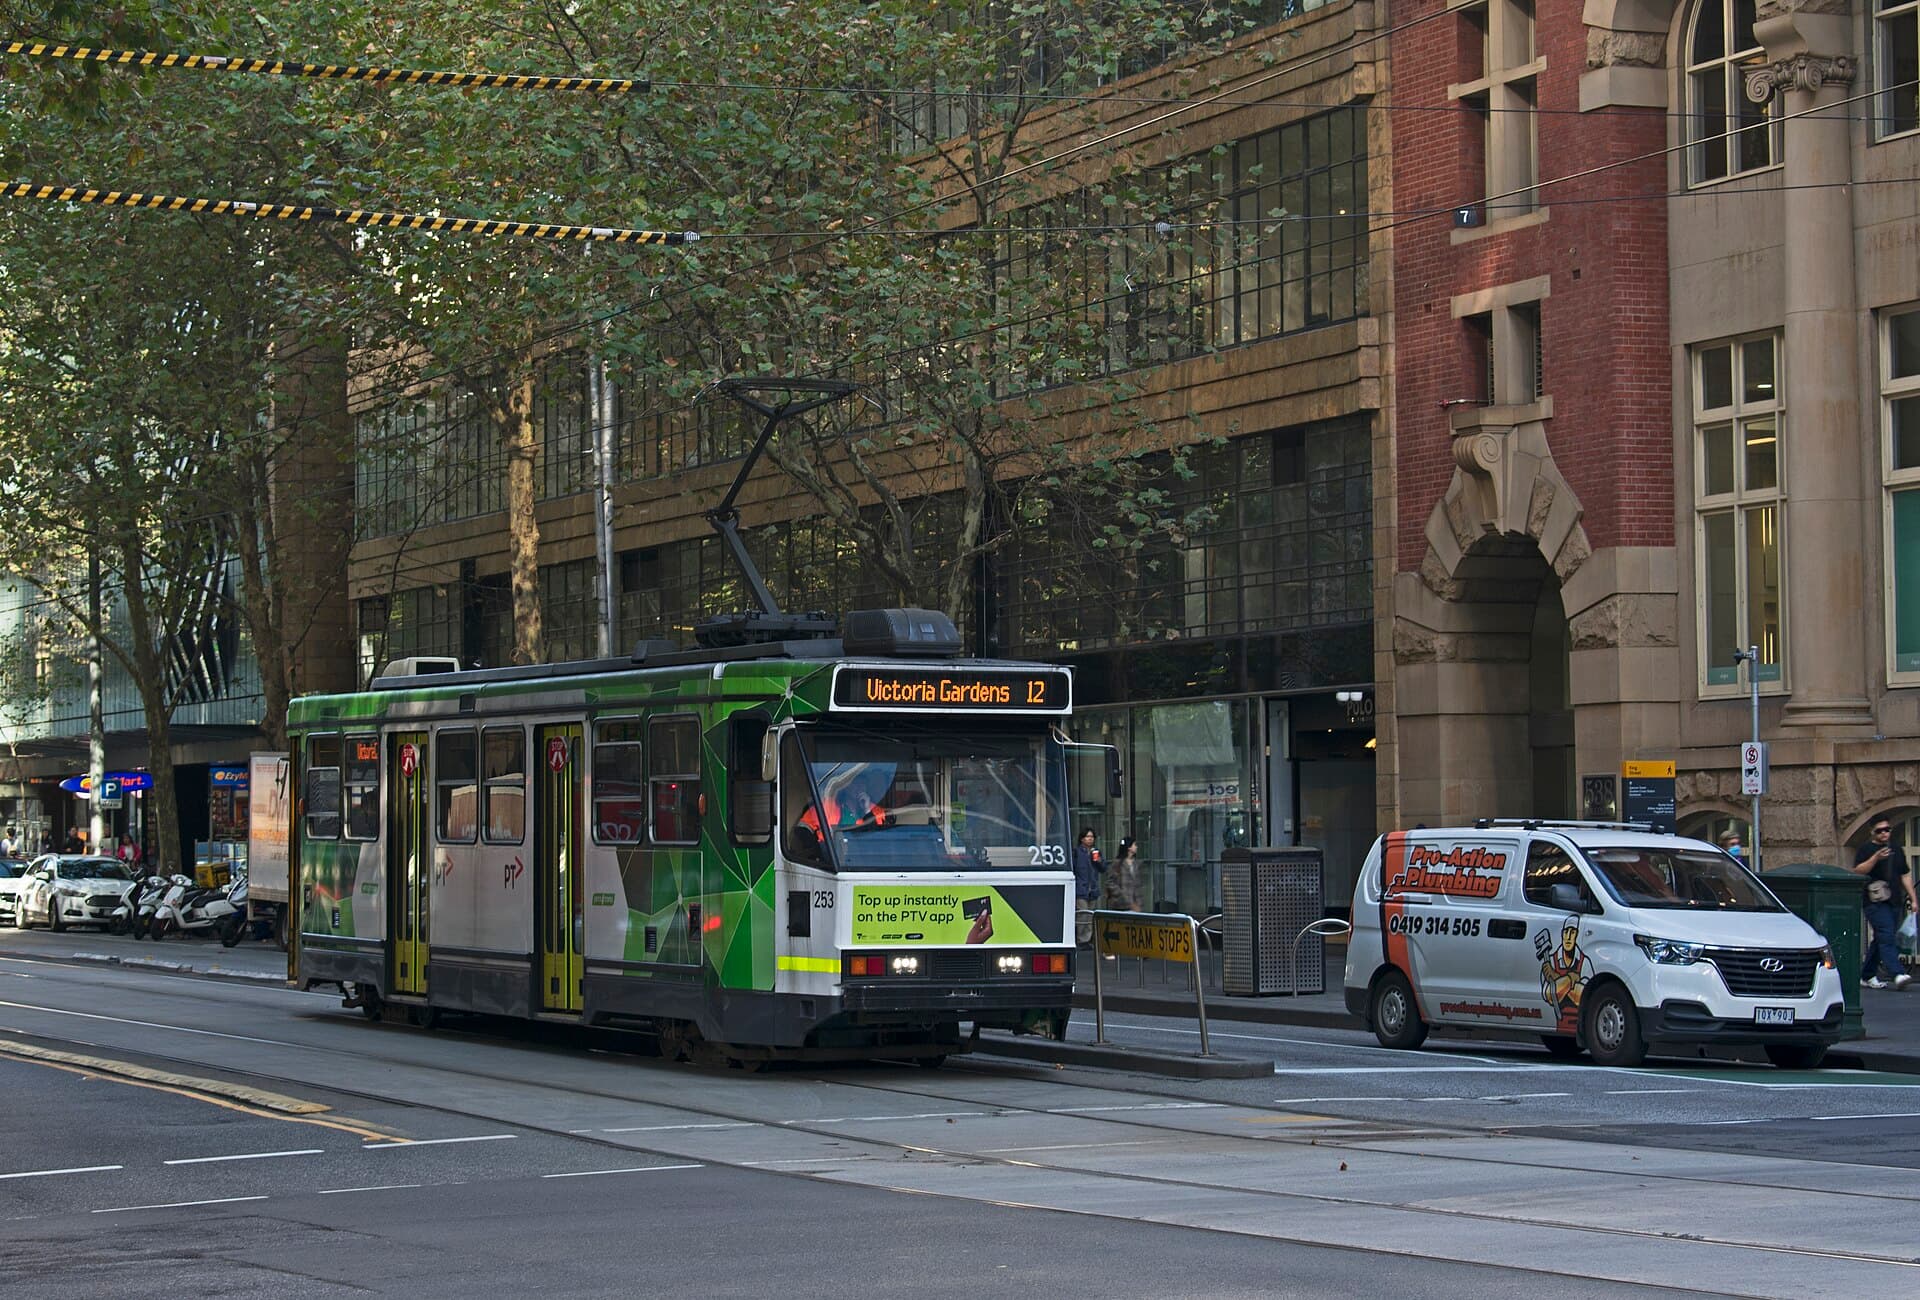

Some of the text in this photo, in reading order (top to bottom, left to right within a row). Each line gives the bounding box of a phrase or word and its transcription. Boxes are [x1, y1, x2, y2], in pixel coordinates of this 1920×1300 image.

[1459, 210, 1469, 224] 7
[867, 678, 1045, 703] Victoria Gardens 12
[551, 741, 563, 751] STOP
[105, 782, 117, 797] P
[1027, 845, 1066, 866] 253
[1405, 867, 1502, 897] Plumbing
[814, 891, 834, 909] 253
[858, 894, 959, 908] Top up instantly
[857, 910, 954, 925] on the PTV app
[1389, 914, 1481, 937] 0419 314 505
[1125, 925, 1190, 955] TRAM STOPS
